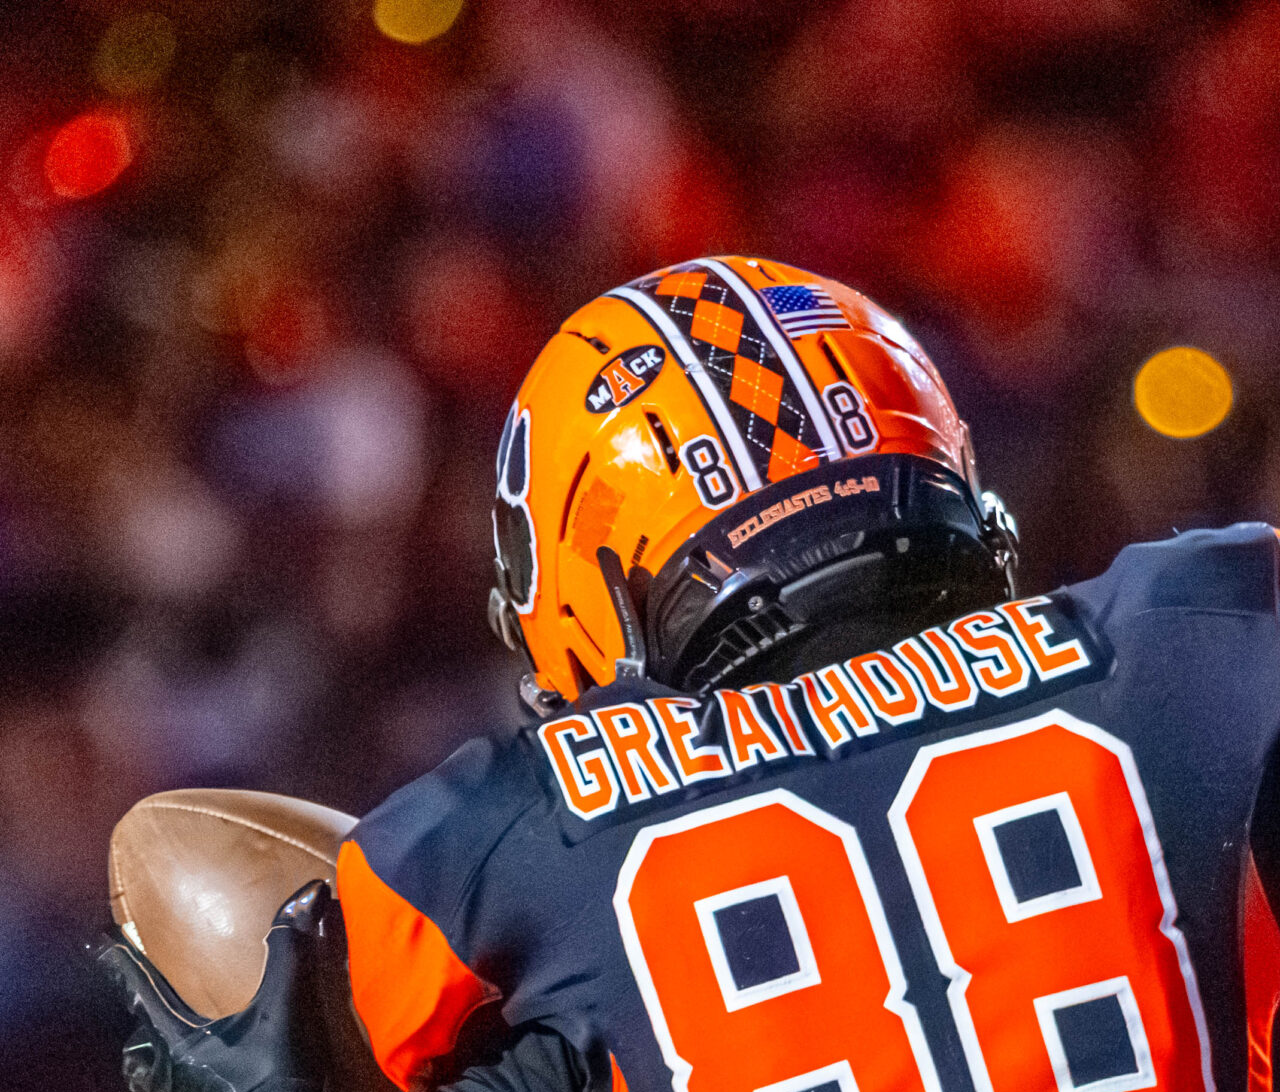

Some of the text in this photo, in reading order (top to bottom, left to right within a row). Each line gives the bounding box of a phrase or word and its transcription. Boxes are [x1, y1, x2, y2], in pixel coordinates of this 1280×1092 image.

[588, 348, 662, 410] MACK
[679, 381, 879, 510] 8 8
[727, 485, 833, 549] ECCLESIASTES
[537, 595, 1091, 821] GREATHOUSE
